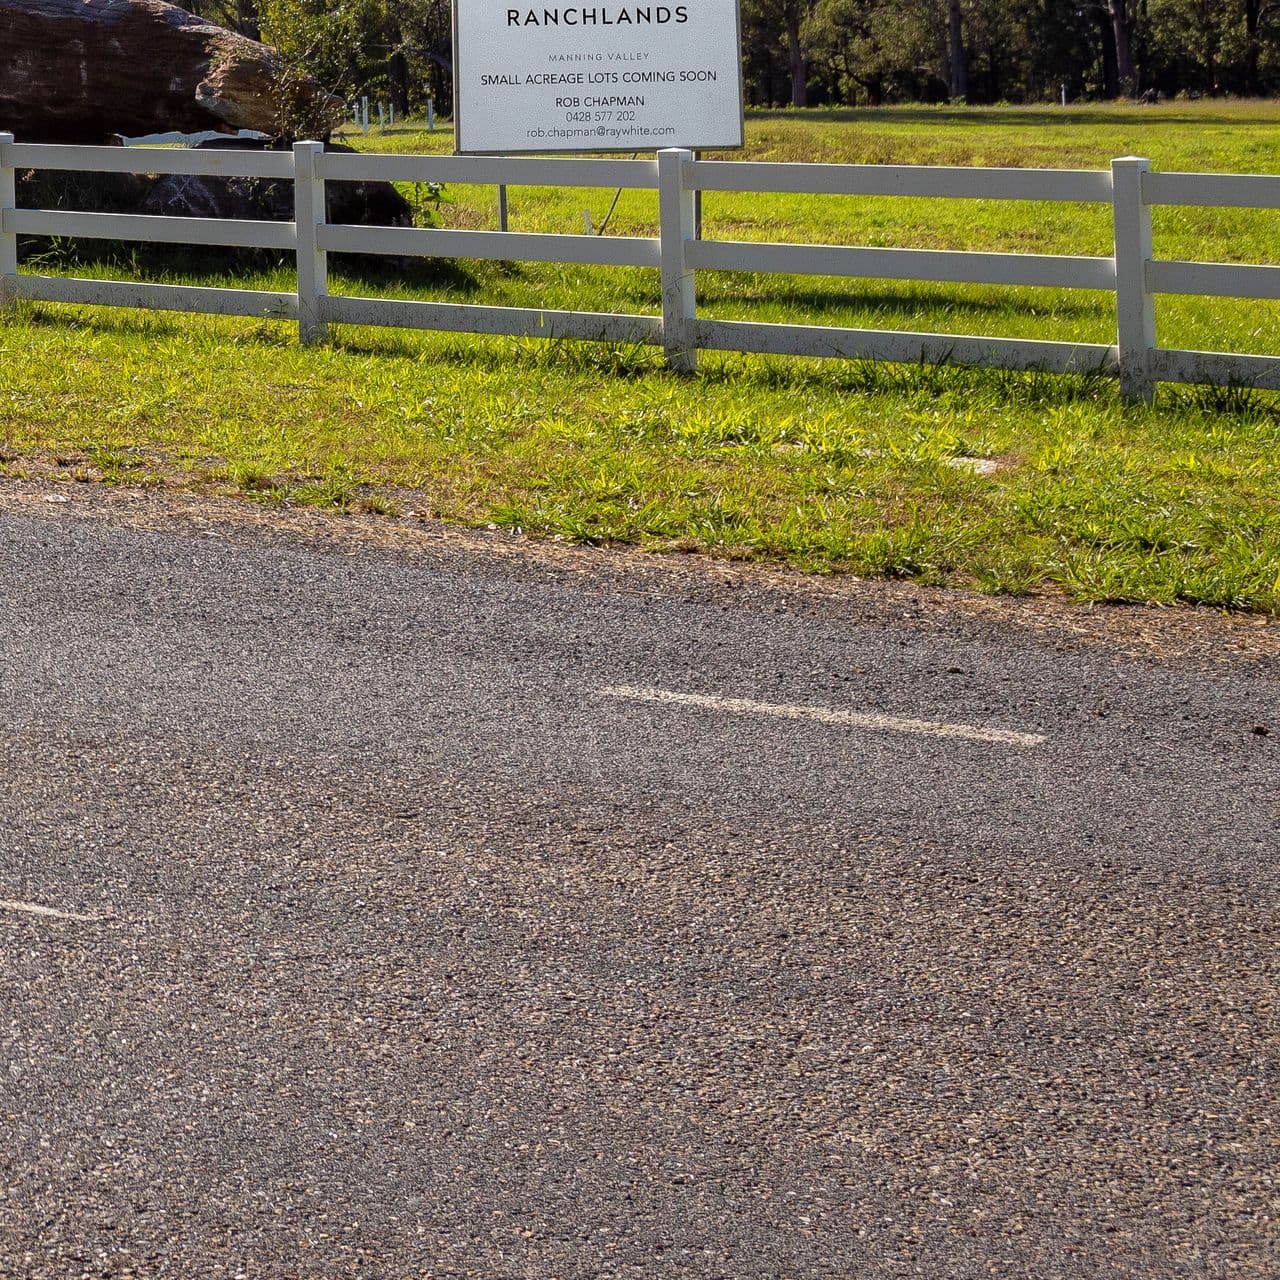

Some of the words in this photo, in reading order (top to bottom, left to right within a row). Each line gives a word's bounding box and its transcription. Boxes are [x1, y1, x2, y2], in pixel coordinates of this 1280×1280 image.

[507, 6, 688, 26] RANCHLANDS
[548, 53, 603, 62] MANNING
[608, 52, 650, 61] VALLEY
[481, 74, 521, 86] SMALL
[526, 73, 584, 85] ACREAGE
[588, 72, 618, 84] LOTS
[623, 71, 675, 83] COMING
[680, 70, 717, 82] SOON
[556, 97, 580, 108] ROB
[584, 96, 645, 107] CHAPMAN
[566, 111, 591, 122] 0428
[594, 111, 612, 122] 577
[617, 111, 635, 122] 202
[526, 126, 675, 139] rob.chapman@raywhite.com
